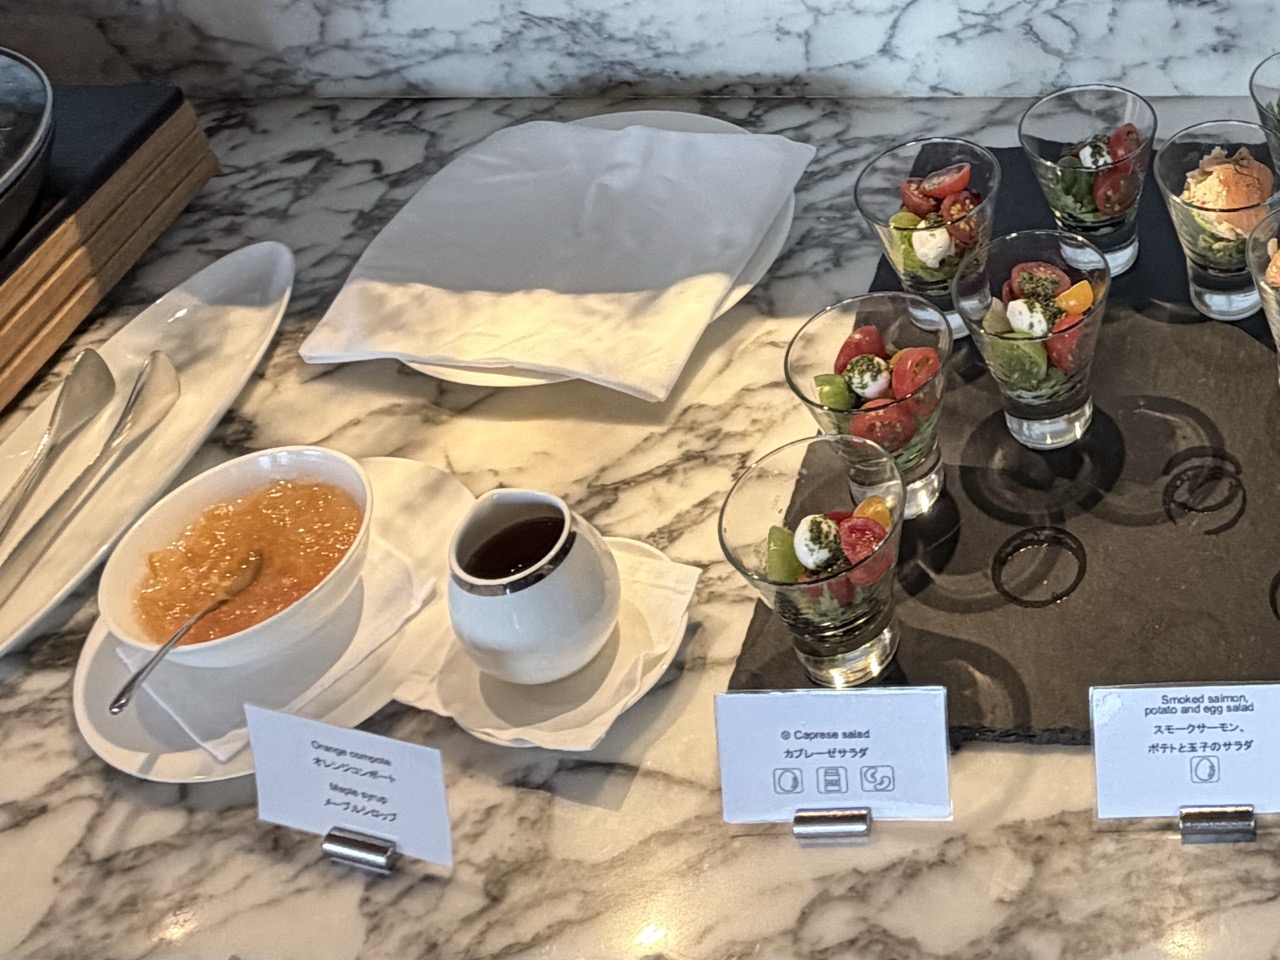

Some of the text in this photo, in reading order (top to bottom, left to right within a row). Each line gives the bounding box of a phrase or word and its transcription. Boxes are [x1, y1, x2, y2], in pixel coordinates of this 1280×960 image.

[1161, 693, 1250, 705] Smoked salmon,
[1144, 702, 1255, 717] potato and egg salad
[793, 729, 871, 742] Caprese salad
[1148, 739, 1254, 754] ポテトと玉子のサラダ
